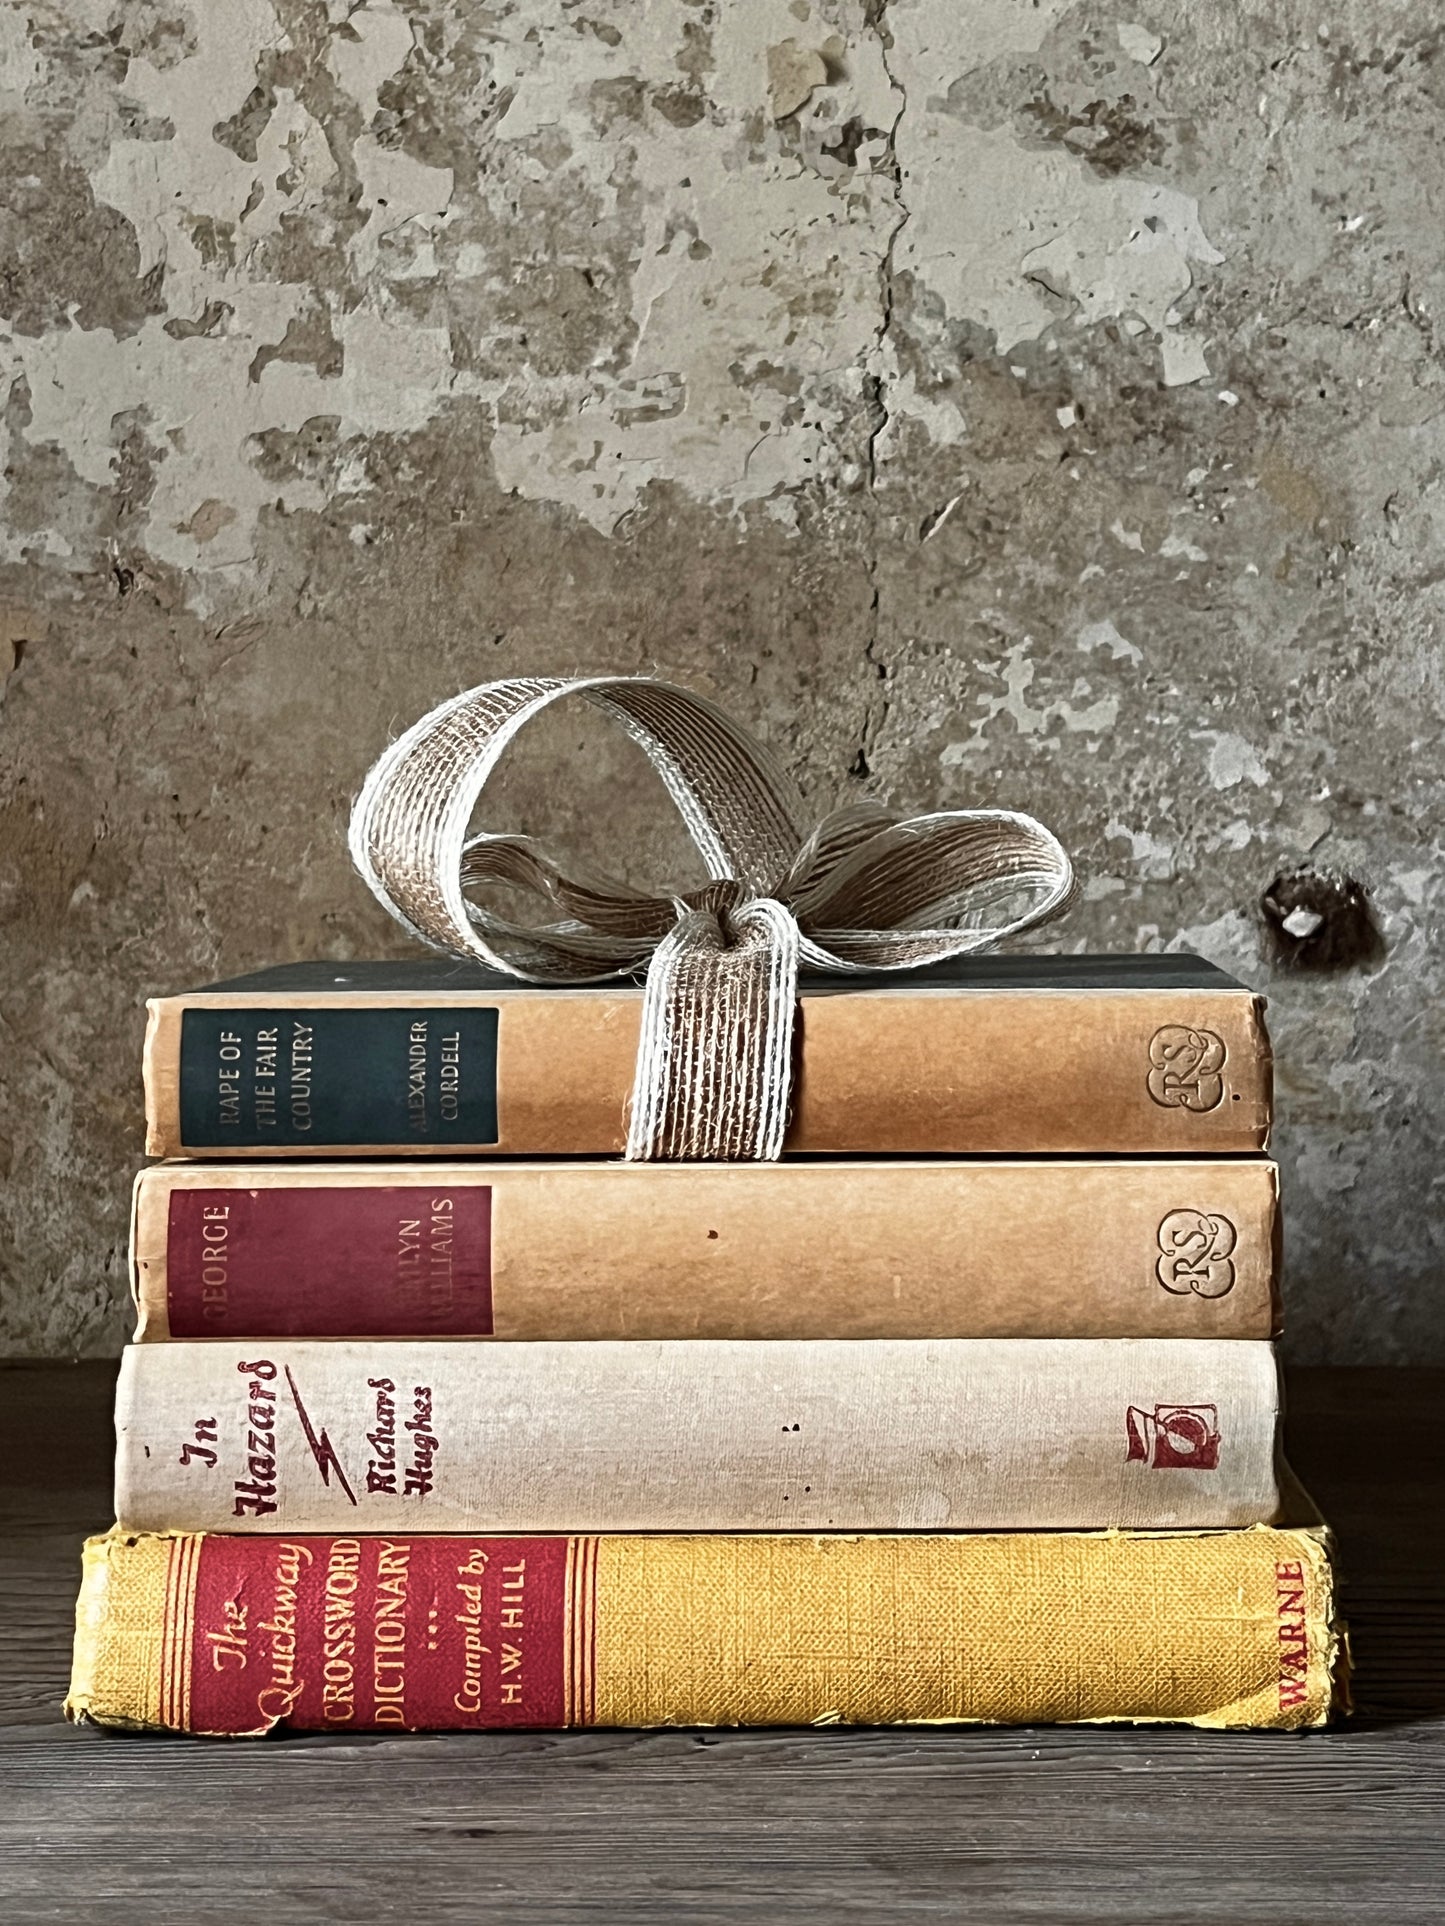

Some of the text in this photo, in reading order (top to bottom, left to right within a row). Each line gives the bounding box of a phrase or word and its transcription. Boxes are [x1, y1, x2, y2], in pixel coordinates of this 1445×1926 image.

[219, 1031, 242, 1124] RAPE OF
[255, 1027, 278, 1130] THE FAIR
[291, 1022, 313, 1131] COUNTRY
[408, 1020, 428, 1133] ALEXANDER
[440, 1031, 460, 1121] CORDELL
[202, 1206, 230, 1320] GEORGE
[179, 1417, 218, 1469] In
[232, 1359, 278, 1517] Hazard
[366, 1377, 397, 1494] Richard
[402, 1386, 439, 1496] Hughes
[206, 1599, 248, 1673] The
[257, 1543, 314, 1721] Quickway
[322, 1538, 361, 1722] CROSSWORD
[374, 1540, 411, 1724] DICTIONARY
[454, 1548, 492, 1713] Compiled by
[501, 1559, 526, 1629] HILL
[1275, 1561, 1310, 1711] WARNE
